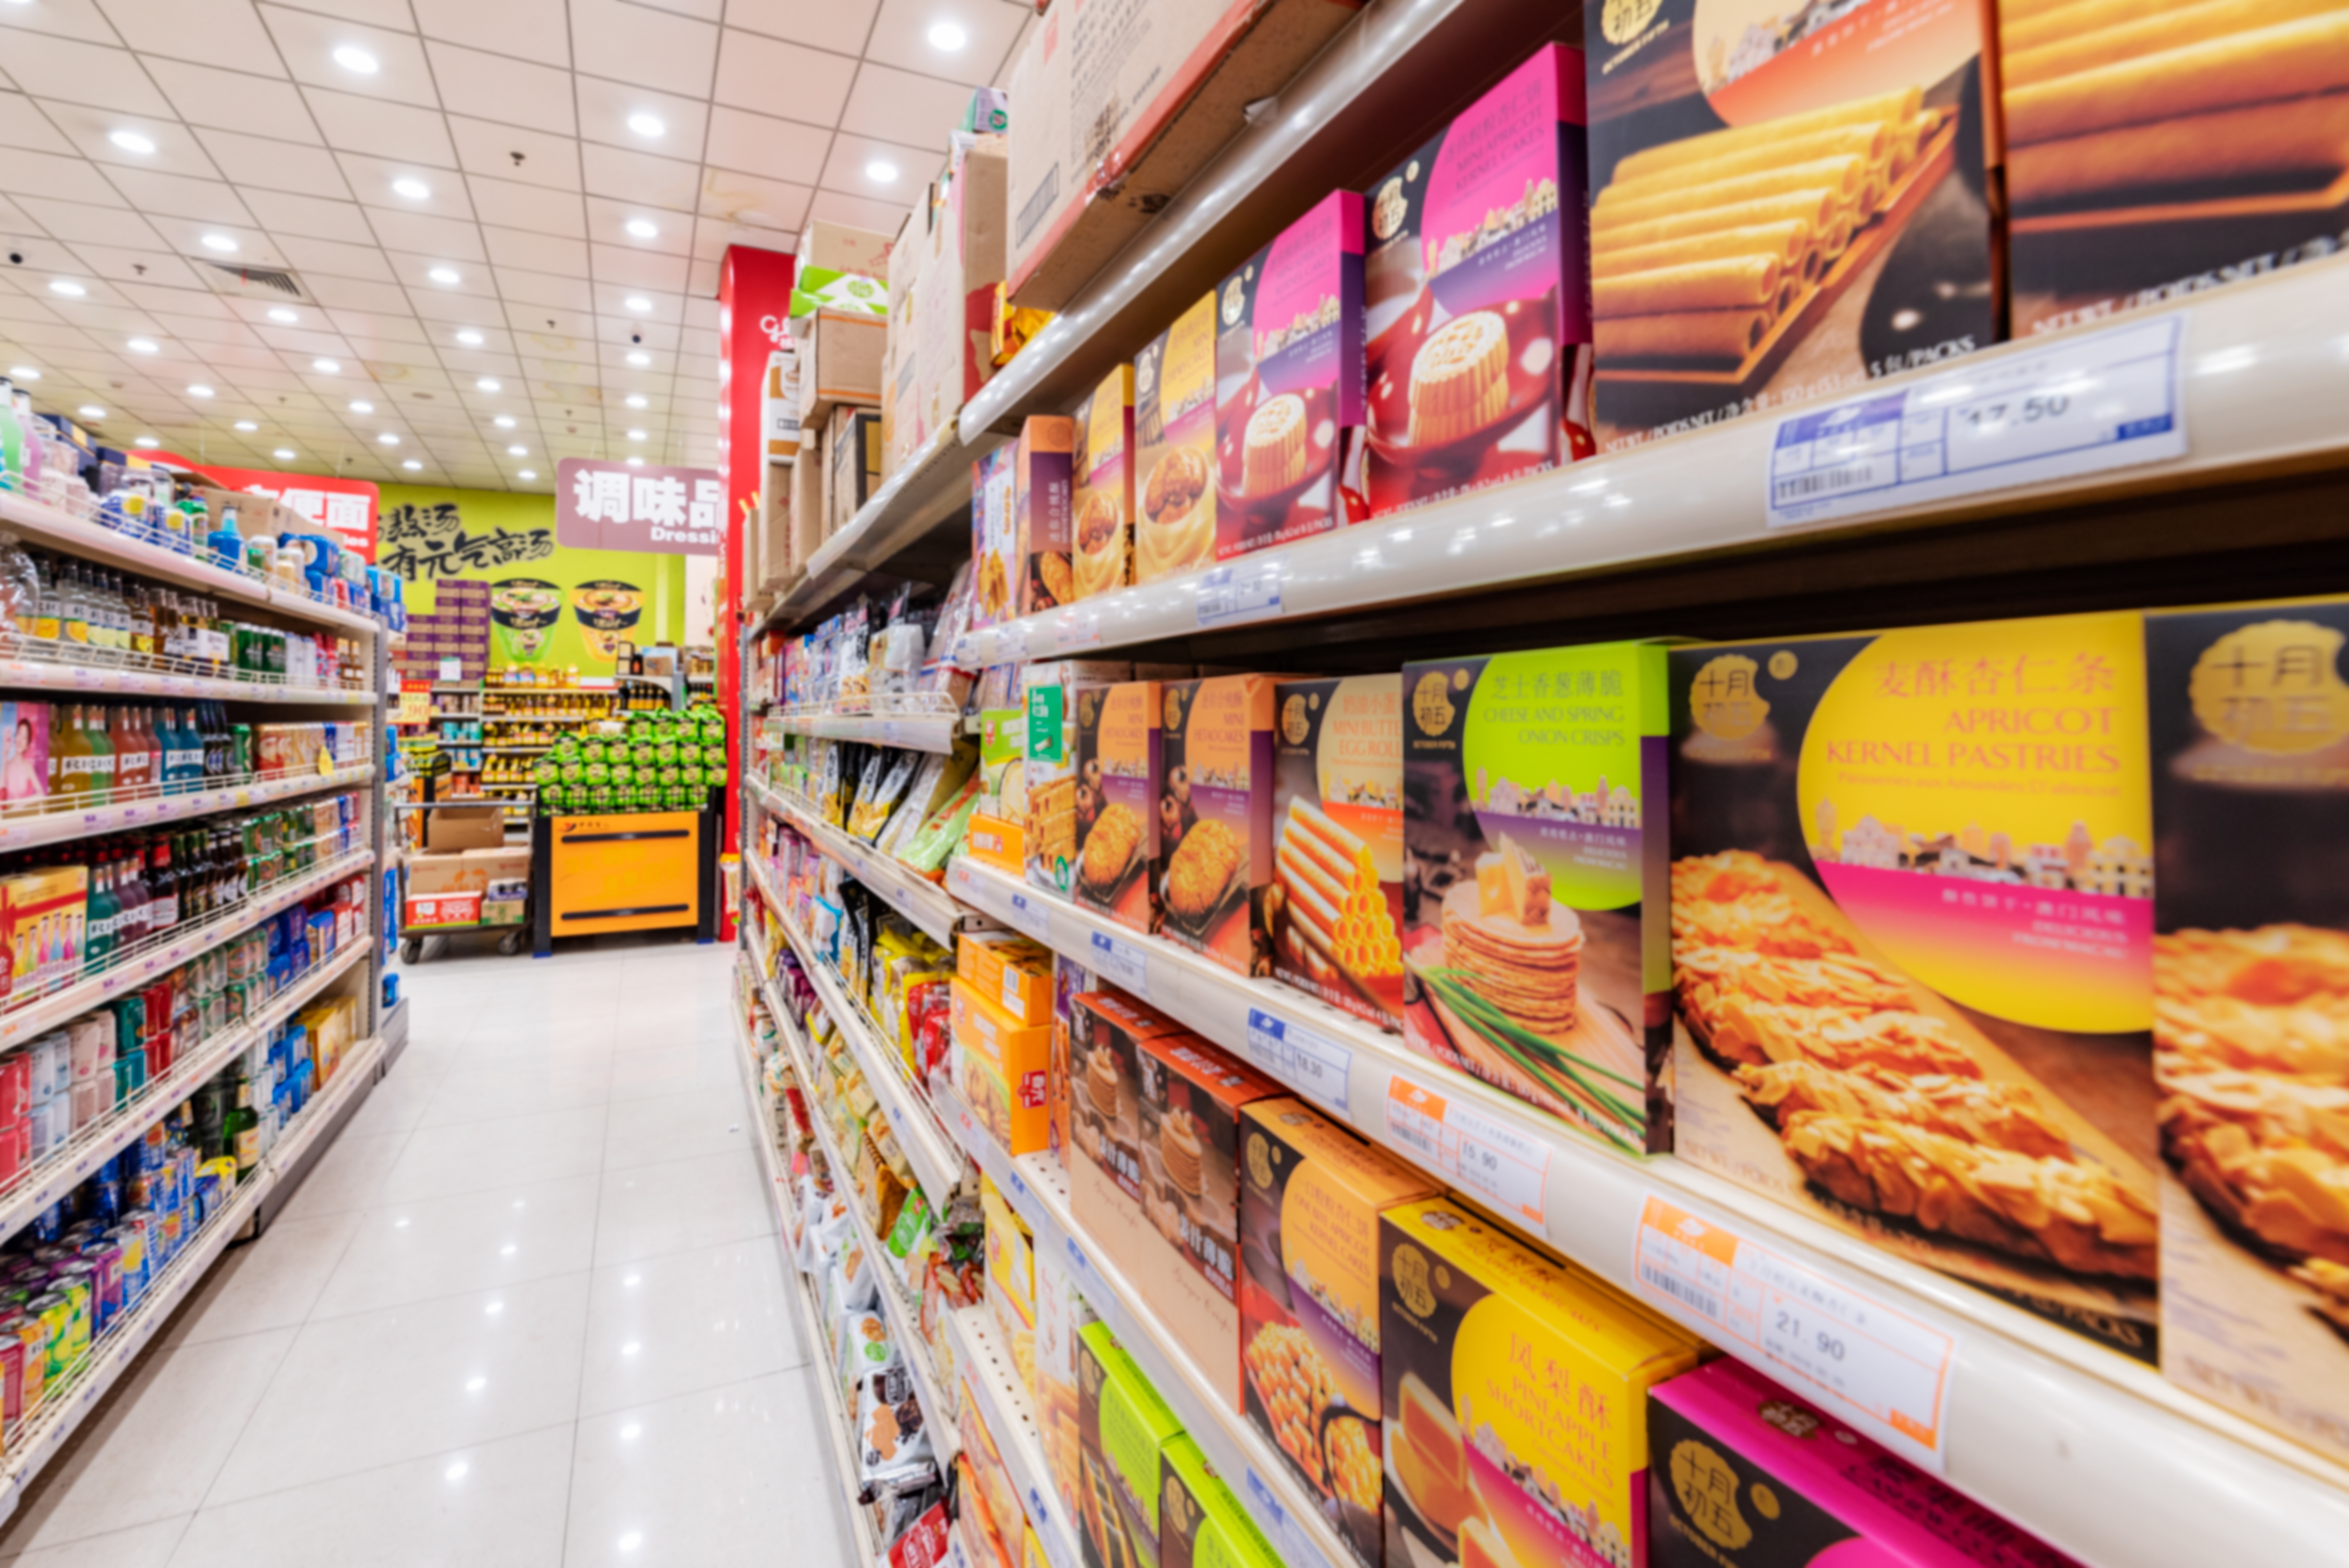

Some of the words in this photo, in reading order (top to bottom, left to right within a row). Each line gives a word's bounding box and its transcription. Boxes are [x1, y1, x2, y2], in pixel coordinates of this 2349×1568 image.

[1486, 102, 1544, 153] APRICOT
[1455, 155, 1497, 192] KERNEL
[1500, 125, 1545, 161] CAKES
[573, 468, 718, 529] 调味品
[651, 526, 717, 544] Dressi
[1873, 650, 2116, 700] 麦酥杏仁条
[2209, 643, 2324, 687] 十月
[1417, 681, 1445, 704] 十月
[1491, 669, 1624, 701] 芝士香葱薄脆
[1698, 668, 1750, 699] 十月
[1223, 712, 1245, 726] MINI
[1342, 692, 1403, 715] 奶油小蛋
[1484, 706, 1528, 723] CHEESE
[1533, 706, 1564, 723] AND
[1566, 706, 1625, 723] SPRING
[1332, 719, 1359, 736] MINI
[1362, 719, 1403, 737] BUTTE
[1942, 705, 2120, 736] APRICOT
[1338, 739, 1366, 756] EGG
[1368, 739, 1403, 757] ROLL
[1518, 728, 1568, 745] ONION
[1571, 728, 1625, 747] CRISPS
[1826, 738, 1939, 768] KERNEL
[1948, 742, 2121, 775] PASTRIES
[1462, 1140, 1499, 1172] 15.90
[1775, 1309, 1846, 1362] 21.90
[1508, 1331, 1613, 1431] 凤梨酥
[1512, 1374, 1613, 1459] PINEAPPLE
[1678, 1449, 1732, 1506] 十月
[1682, 1482, 1735, 1539] 初五
